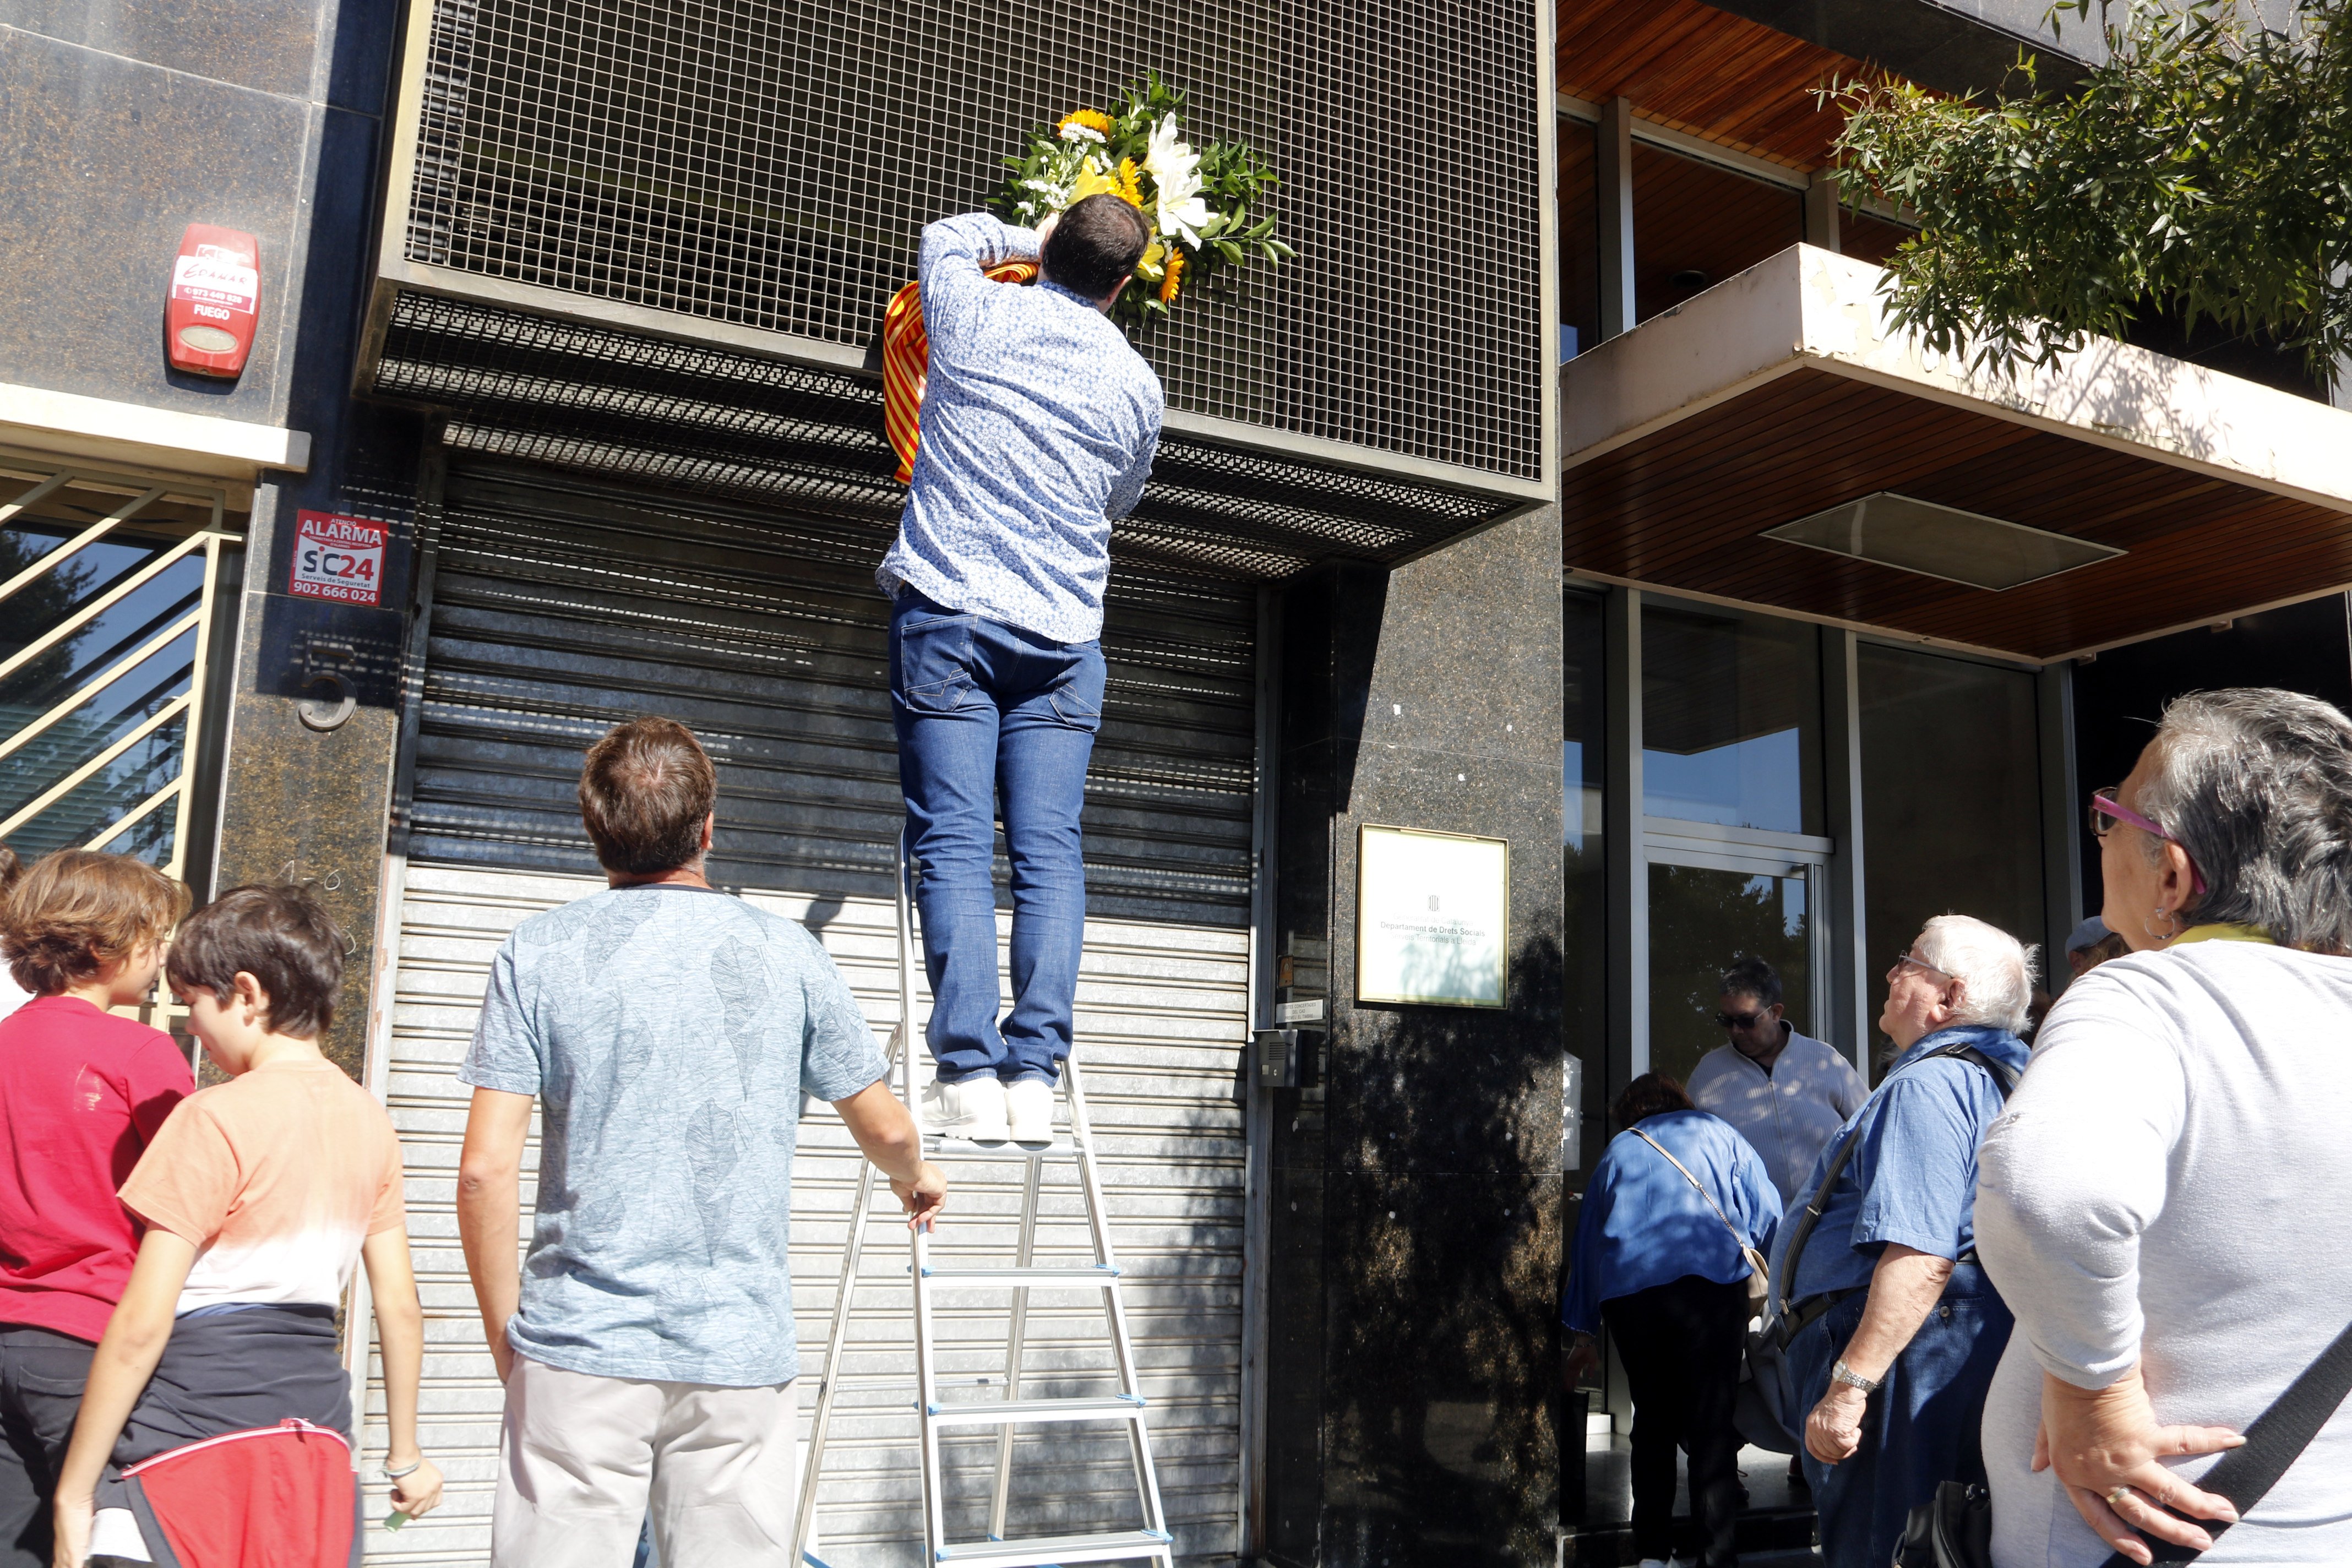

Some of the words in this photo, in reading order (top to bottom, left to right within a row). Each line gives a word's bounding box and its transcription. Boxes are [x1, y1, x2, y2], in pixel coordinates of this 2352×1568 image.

[193, 288, 208, 297] 973
[210, 291, 226, 300] 449
[226, 293, 242, 303] 828
[194, 303, 230, 320] FUEGO
[331, 518, 357, 527] ATENCIÓ
[301, 519, 383, 545] ALARMA
[302, 573, 326, 582] Serveis
[337, 578, 371, 589] Seguretat
[294, 581, 319, 595] 902
[322, 586, 348, 599] 666
[351, 590, 376, 603] 024
[297, 640, 357, 732] 5
[1380, 921, 1427, 933] Departament
[1439, 926, 1458, 934] Drets
[1460, 928, 1485, 937] Socials
[1441, 917, 1473, 927] Catalunya
[1417, 934, 1449, 943] Territorials
[1457, 937, 1476, 945] Lleida
